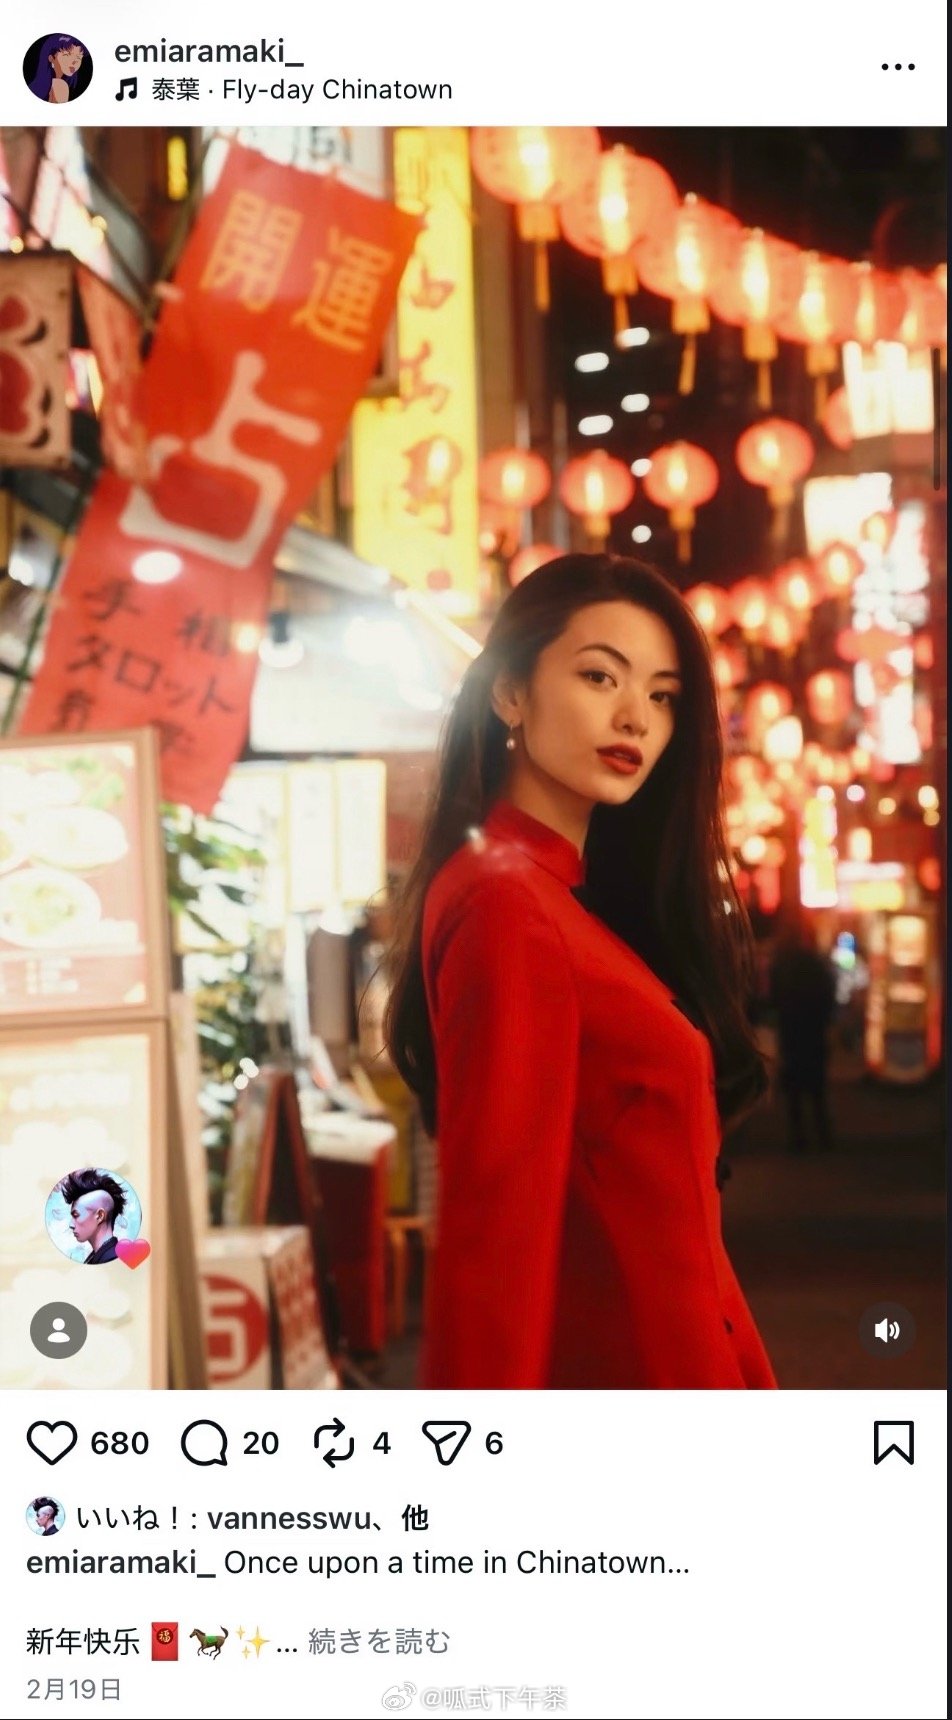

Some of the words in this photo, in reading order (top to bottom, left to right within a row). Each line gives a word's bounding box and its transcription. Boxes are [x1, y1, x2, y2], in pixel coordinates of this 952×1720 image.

[200, 187, 397, 353] 開運
[117, 350, 322, 569] 占
[67, 632, 235, 719] タロット
